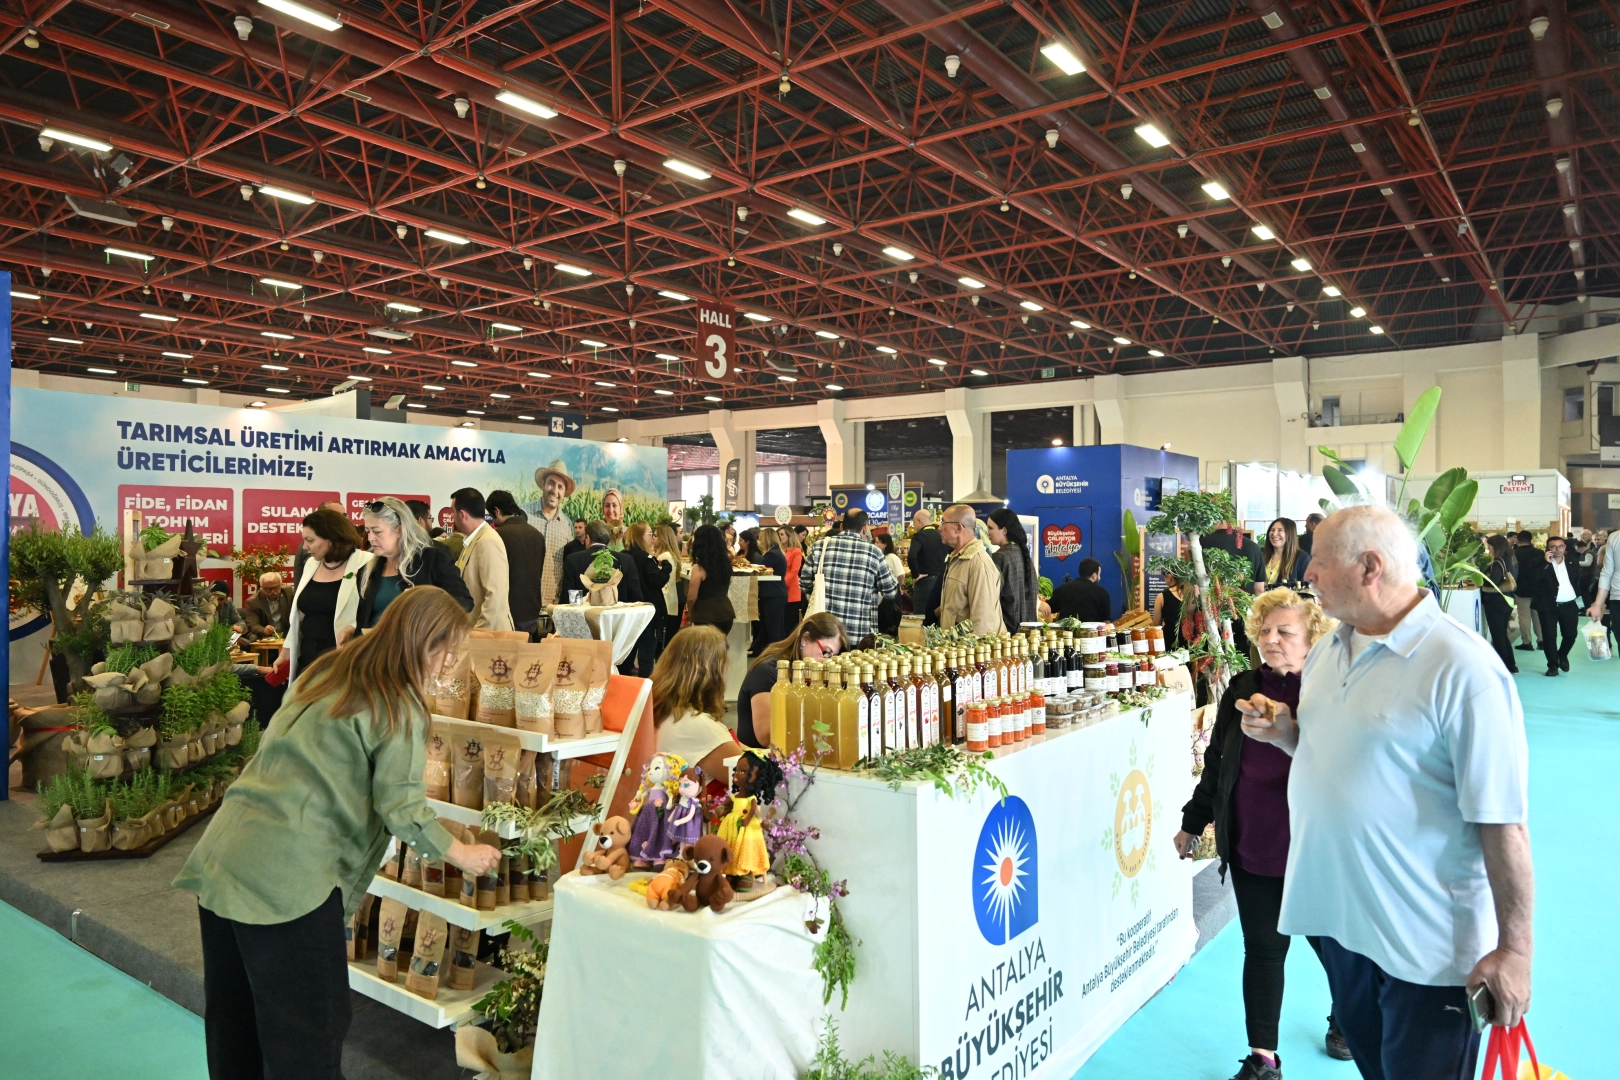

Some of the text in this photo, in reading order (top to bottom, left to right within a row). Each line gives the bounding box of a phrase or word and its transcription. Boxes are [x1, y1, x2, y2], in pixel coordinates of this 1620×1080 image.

[700, 308, 732, 329] HALL
[704, 334, 728, 379] 3
[117, 420, 506, 464] TARIMSAL ÜRETİMİ ARTIRMAK AMACIYLA
[117, 447, 314, 481] ÜRETİCİLERİMİZE;
[124, 493, 228, 511] FİDE, FİDAN
[261, 506, 318, 518] SULAM
[247, 522, 303, 534] DESTEK
[1127, 908, 1151, 941] kooperatif
[1081, 907, 1178, 999] Antalya Büyükşehir Belediyesi tarafından
[965, 935, 1046, 1021] ANTALYA
[941, 966, 1064, 1080] BÜYÜKŞEHİR
